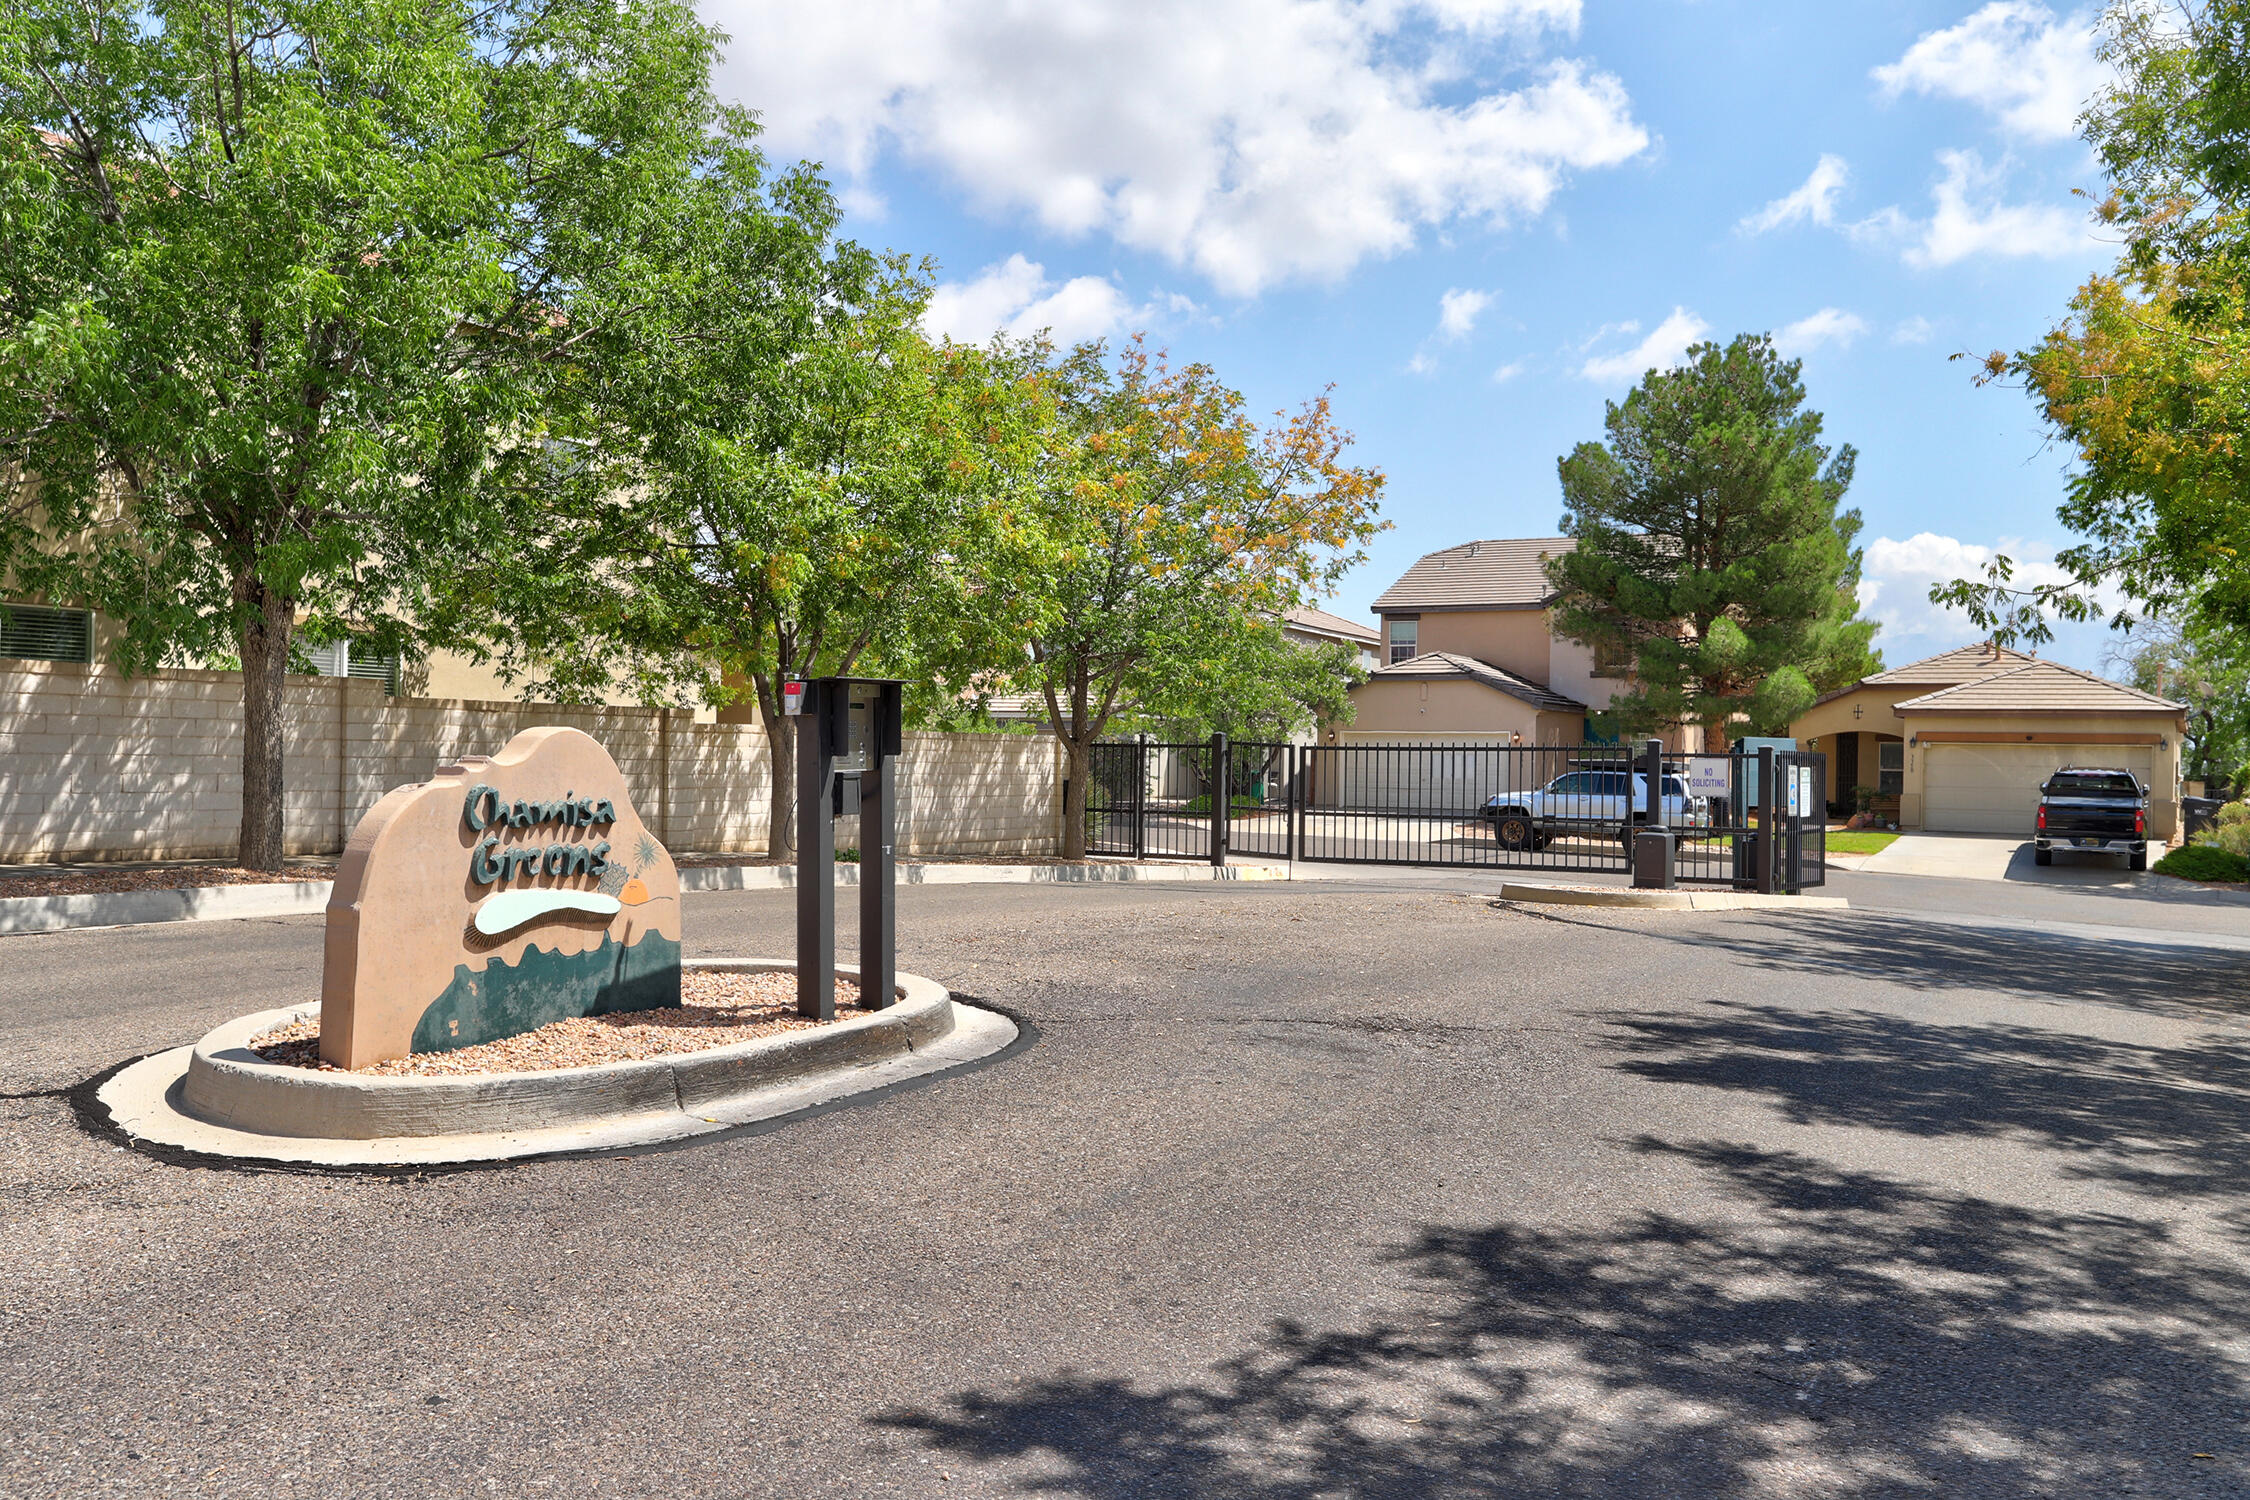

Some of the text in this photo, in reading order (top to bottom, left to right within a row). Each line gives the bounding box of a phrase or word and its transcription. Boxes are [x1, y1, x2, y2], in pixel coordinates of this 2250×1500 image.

[1692, 778, 1725, 787] SOLICITING
[1704, 767, 1713, 777] NO
[463, 783, 617, 832] Chamisa
[470, 836, 611, 886] Greens
